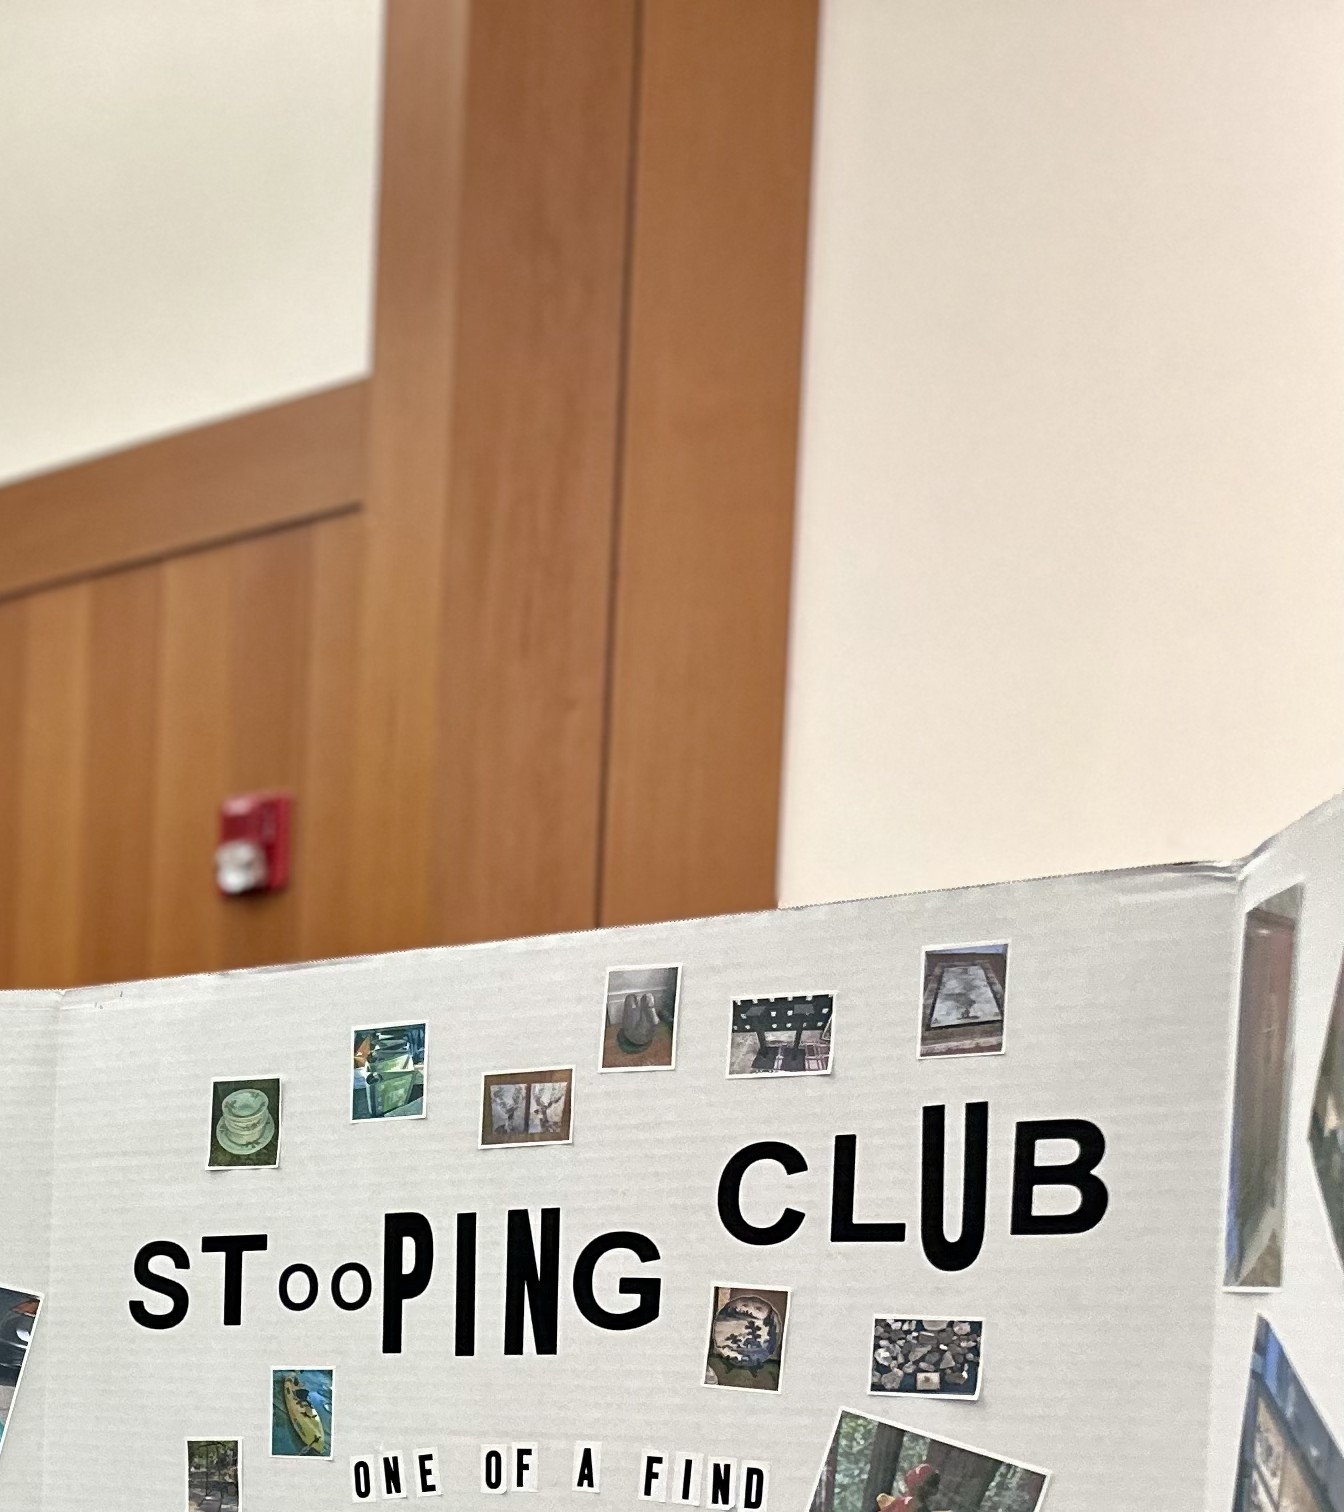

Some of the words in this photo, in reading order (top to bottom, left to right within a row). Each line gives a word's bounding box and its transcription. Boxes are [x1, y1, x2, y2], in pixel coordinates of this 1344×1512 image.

[717, 1101, 1109, 1271] CLUB
[353, 1453, 437, 1499] ONE
[485, 1448, 531, 1490] OF
[577, 1448, 595, 1489] A
[643, 1455, 764, 1510] FIND
